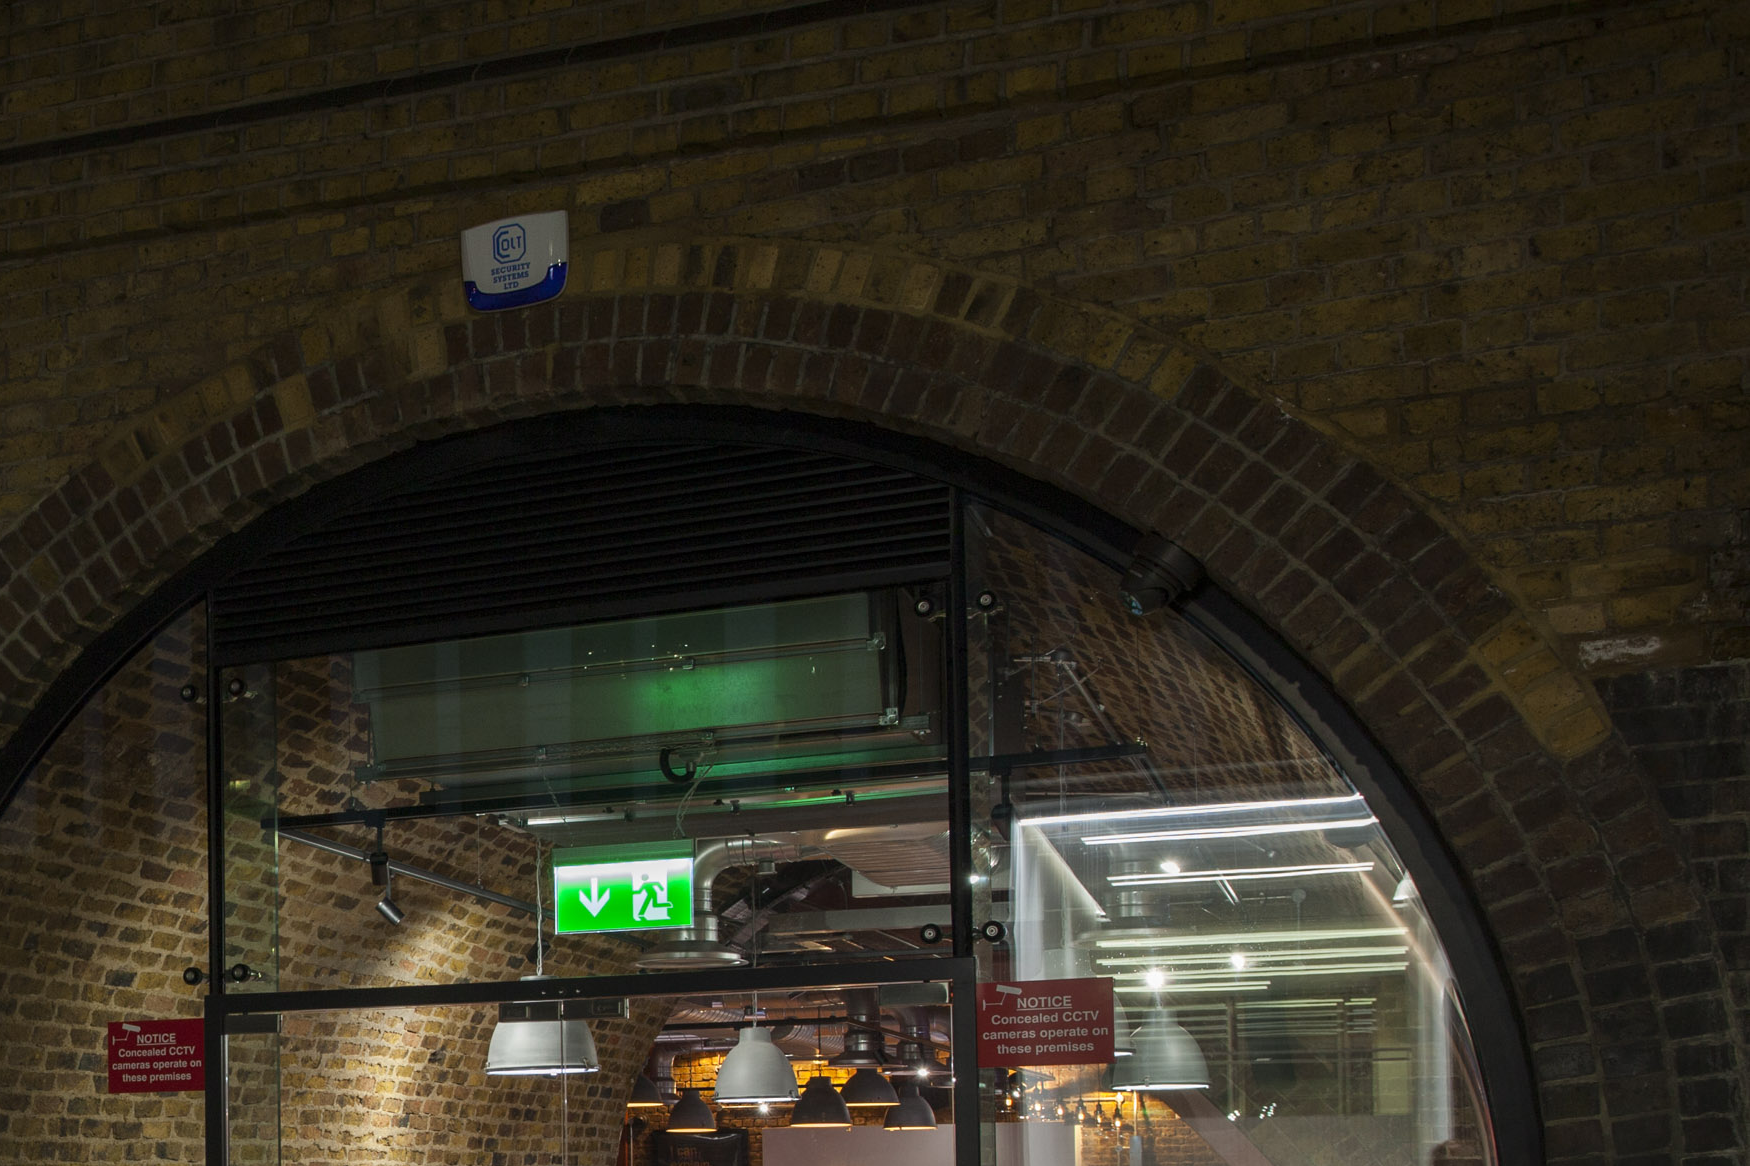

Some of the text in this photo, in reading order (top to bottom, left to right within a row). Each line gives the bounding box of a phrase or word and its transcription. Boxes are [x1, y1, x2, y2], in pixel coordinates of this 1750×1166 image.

[490, 262, 531, 276] SECURITY
[493, 271, 529, 284] SYSTEMS
[503, 281, 519, 290] LTD
[1016, 996, 1072, 1009] NOTICE
[991, 1010, 1099, 1025] Concealed CCTV
[136, 1033, 176, 1044] NOTICE
[982, 1026, 1108, 1040] cameras operate on
[118, 1046, 196, 1058] Concealed CCTV
[997, 1041, 1095, 1056] these premises
[112, 1061, 151, 1070] cameras
[152, 1059, 188, 1070] operate
[122, 1072, 192, 1083] these premises
